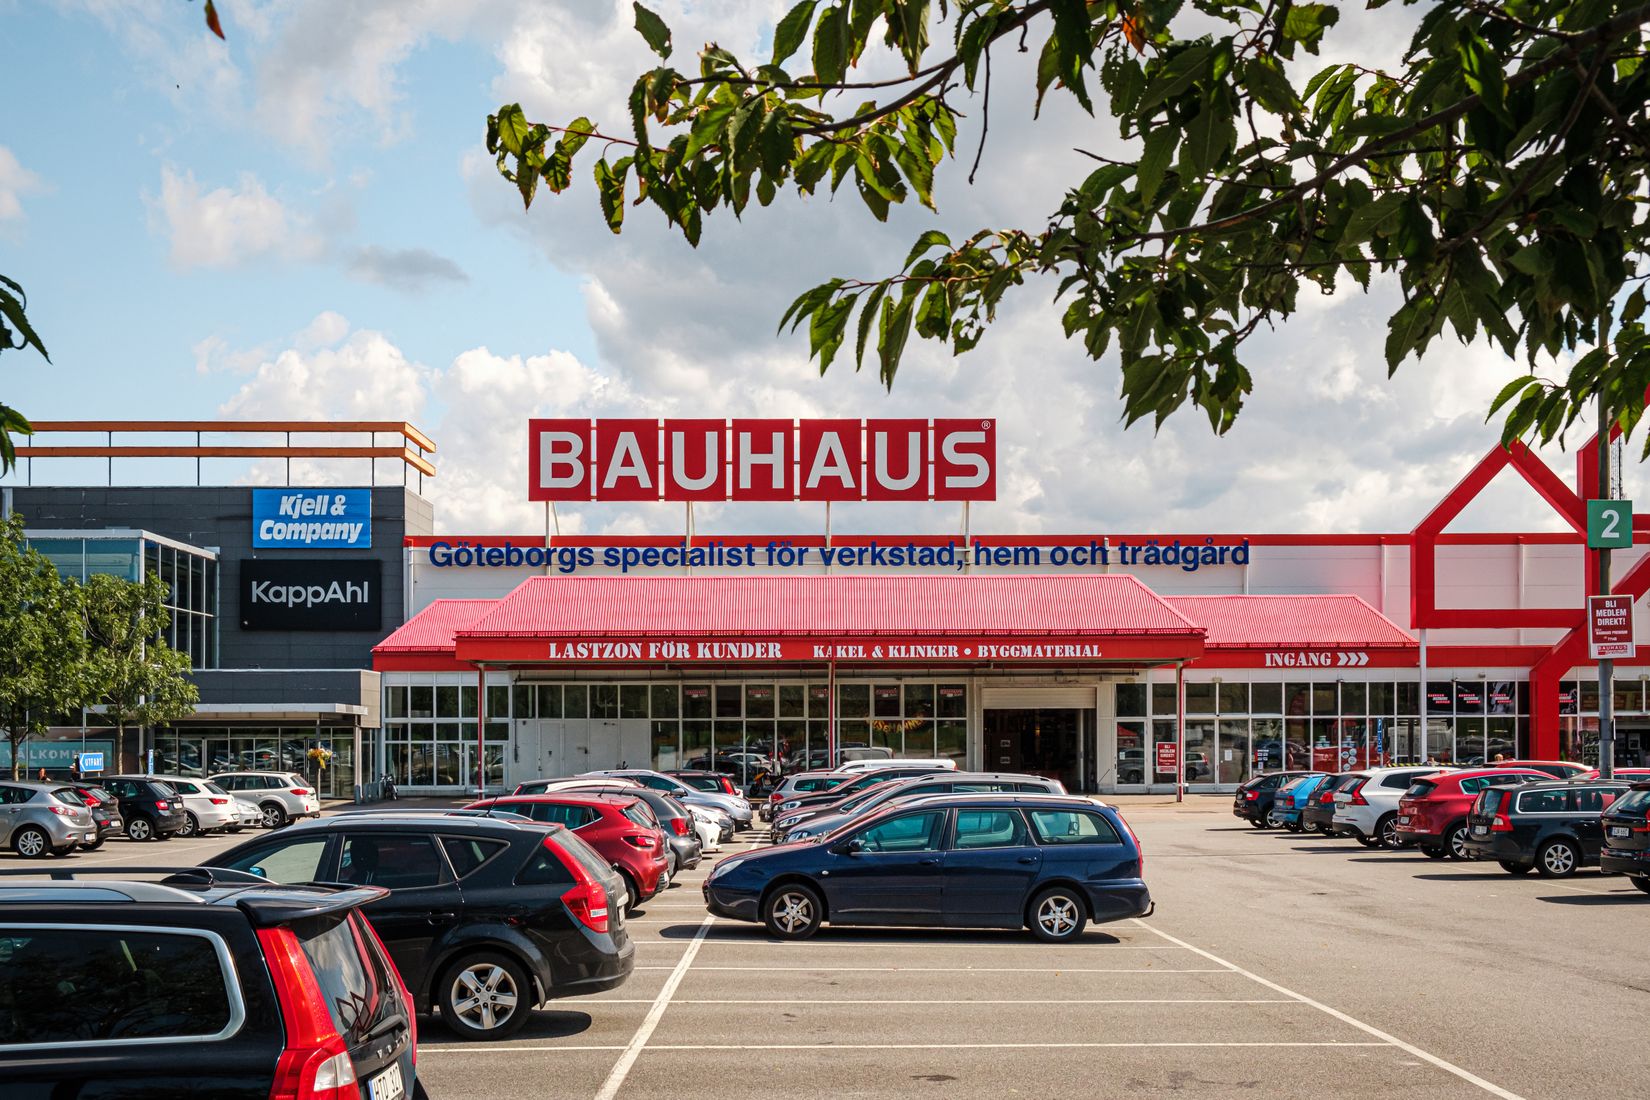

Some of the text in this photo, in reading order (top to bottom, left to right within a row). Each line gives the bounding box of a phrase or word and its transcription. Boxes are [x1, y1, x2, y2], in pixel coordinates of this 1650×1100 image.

[539, 430, 990, 491] BAUHAUS
[279, 493, 347, 519] Kjell &
[259, 519, 364, 544] Company
[1601, 509, 1620, 539] 2
[429, 537, 1250, 573] Göteborgs specialist för verkstad, hem och trädgård
[251, 580, 369, 608] KappAhl
[1604, 599, 1617, 608] BLI
[1595, 608, 1627, 617] MEDLEM
[1597, 617, 1626, 626] DIREKT!
[548, 640, 782, 659] LASTZON FÖR KUNDER
[871, 645, 884, 658] &
[888, 645, 959, 658] KLINKER
[977, 644, 1102, 658] BYGGMATERIAL
